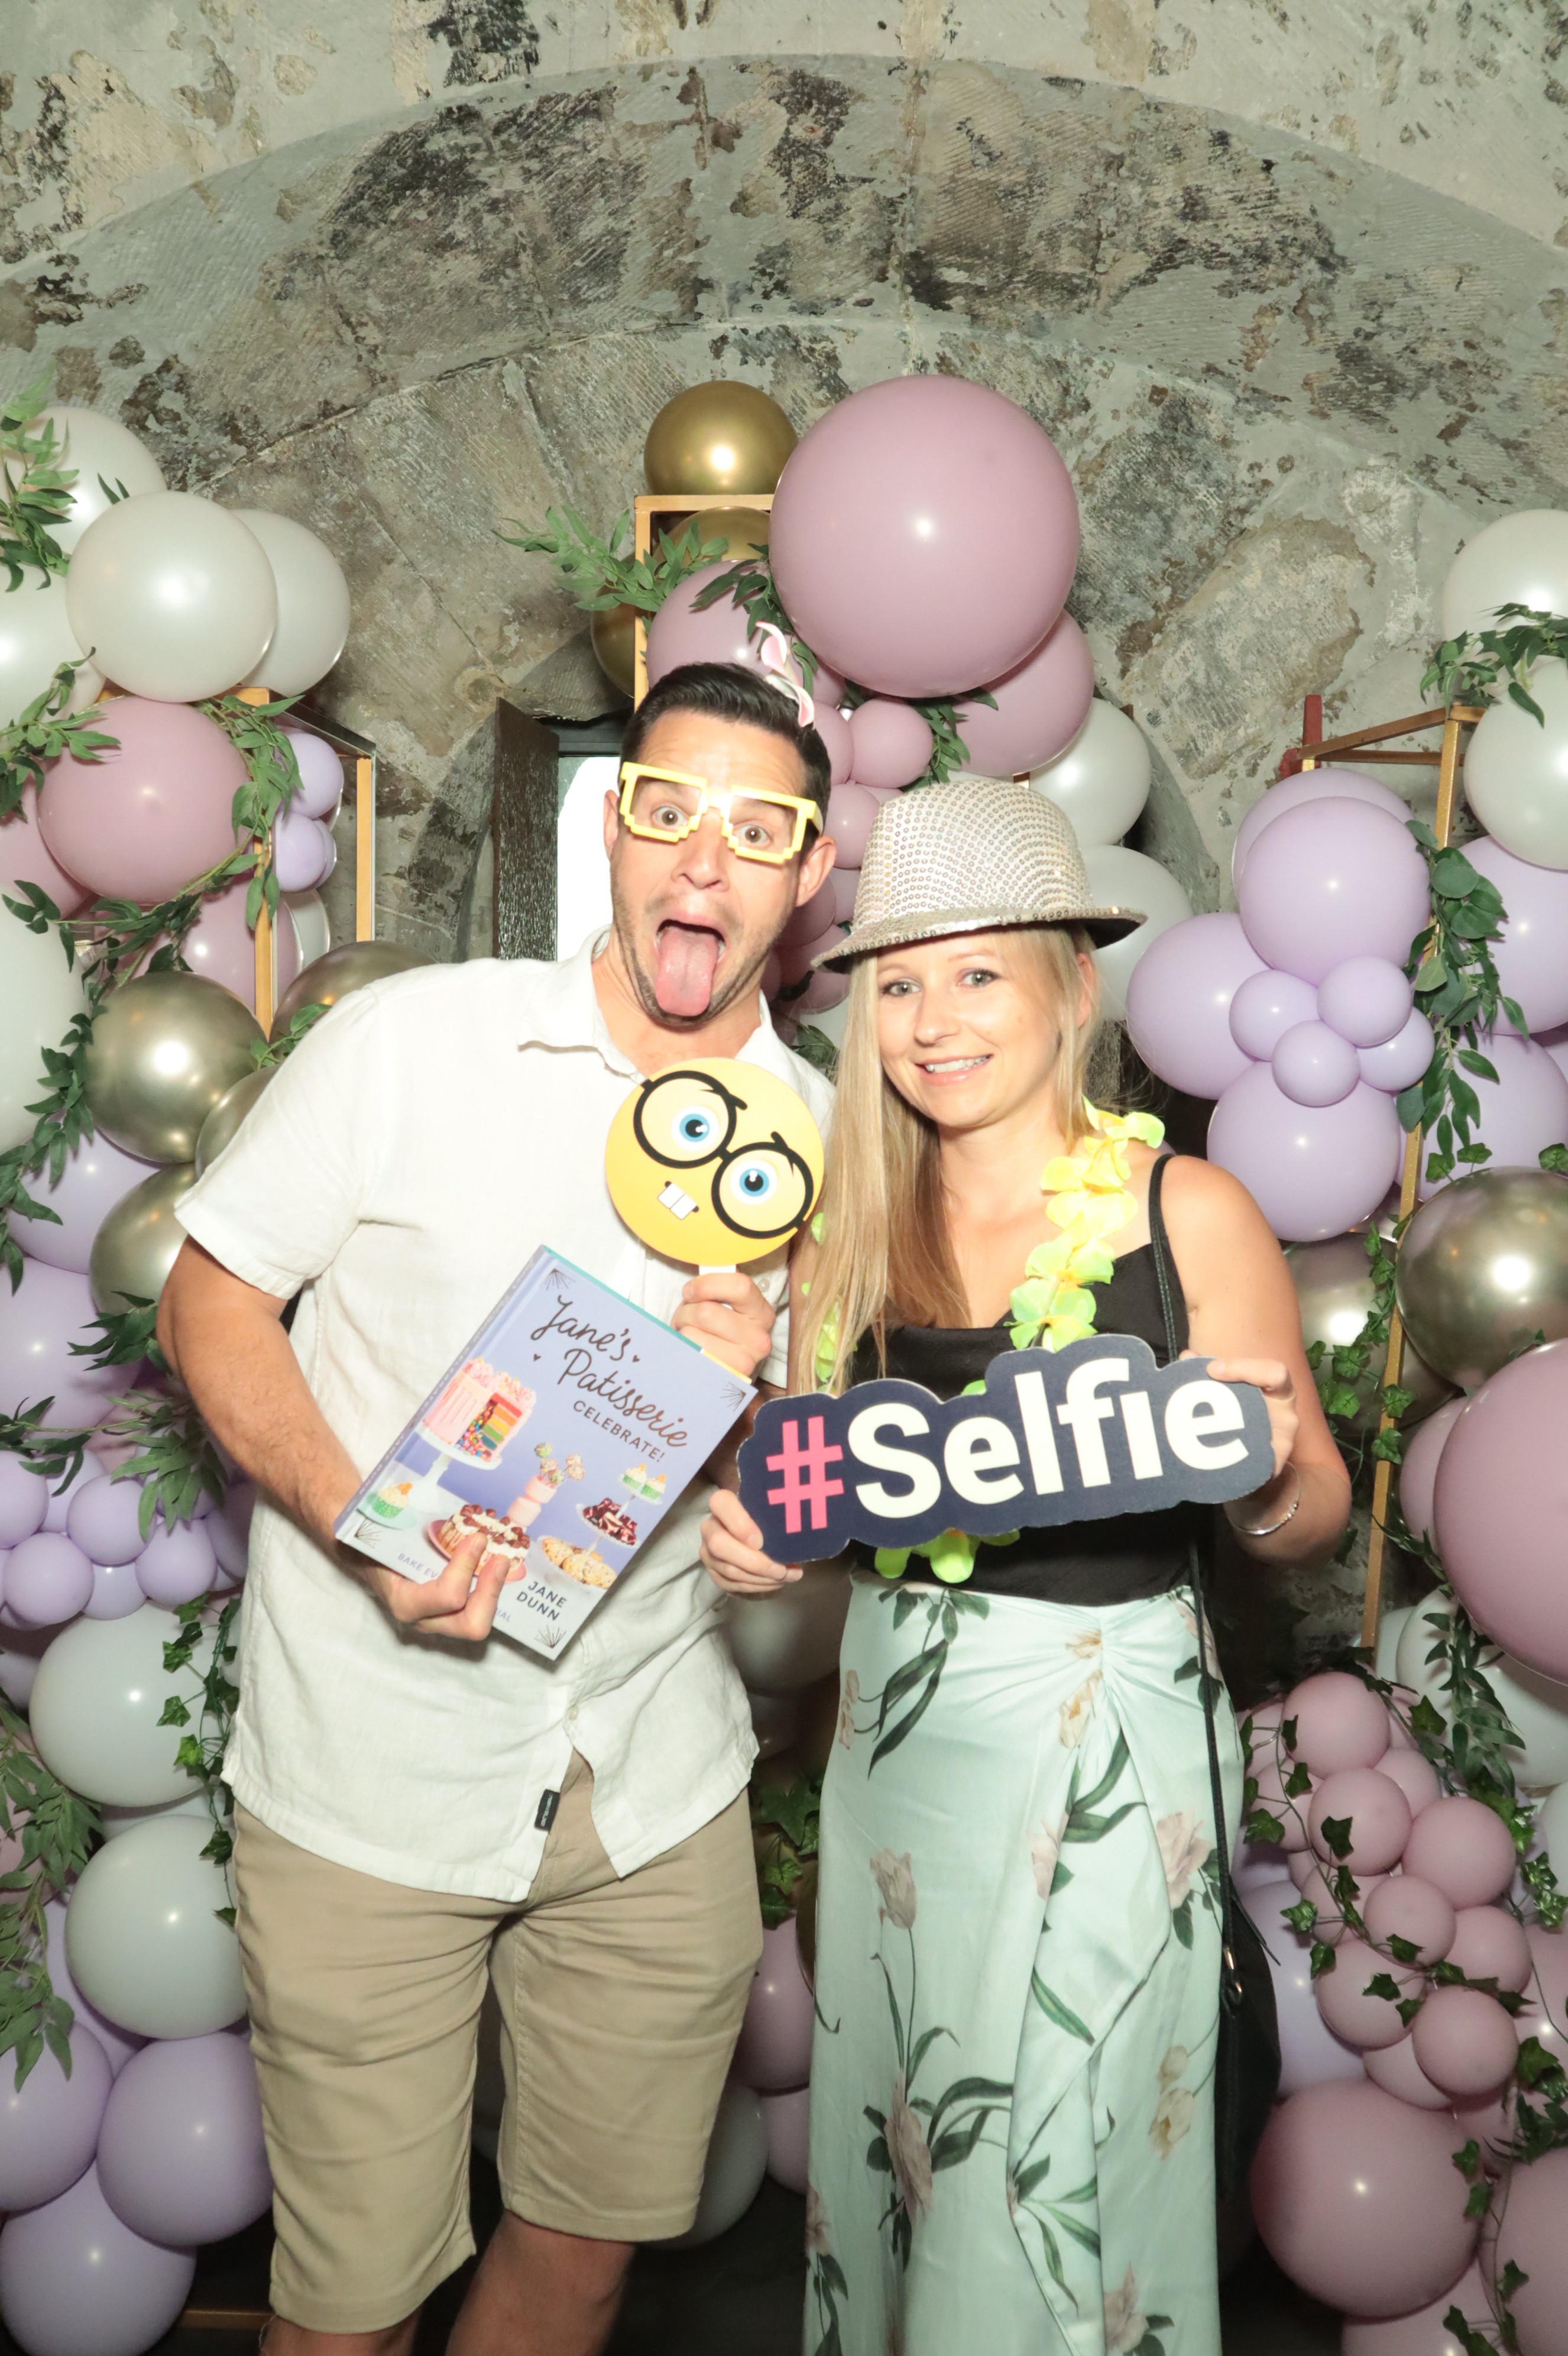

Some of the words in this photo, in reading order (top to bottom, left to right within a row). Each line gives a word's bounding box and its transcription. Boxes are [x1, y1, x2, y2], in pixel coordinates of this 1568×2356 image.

[531, 1294, 631, 1361] Jane's
[557, 1348, 688, 1447] Patisserie
[573, 1400, 665, 1462] CELEBRATE!
[766, 1358, 1250, 1535] #Selfie
[397, 1553, 424, 1572] BAKE
[516, 1591, 560, 1622] DUNN
[527, 1581, 568, 1608] JANE
